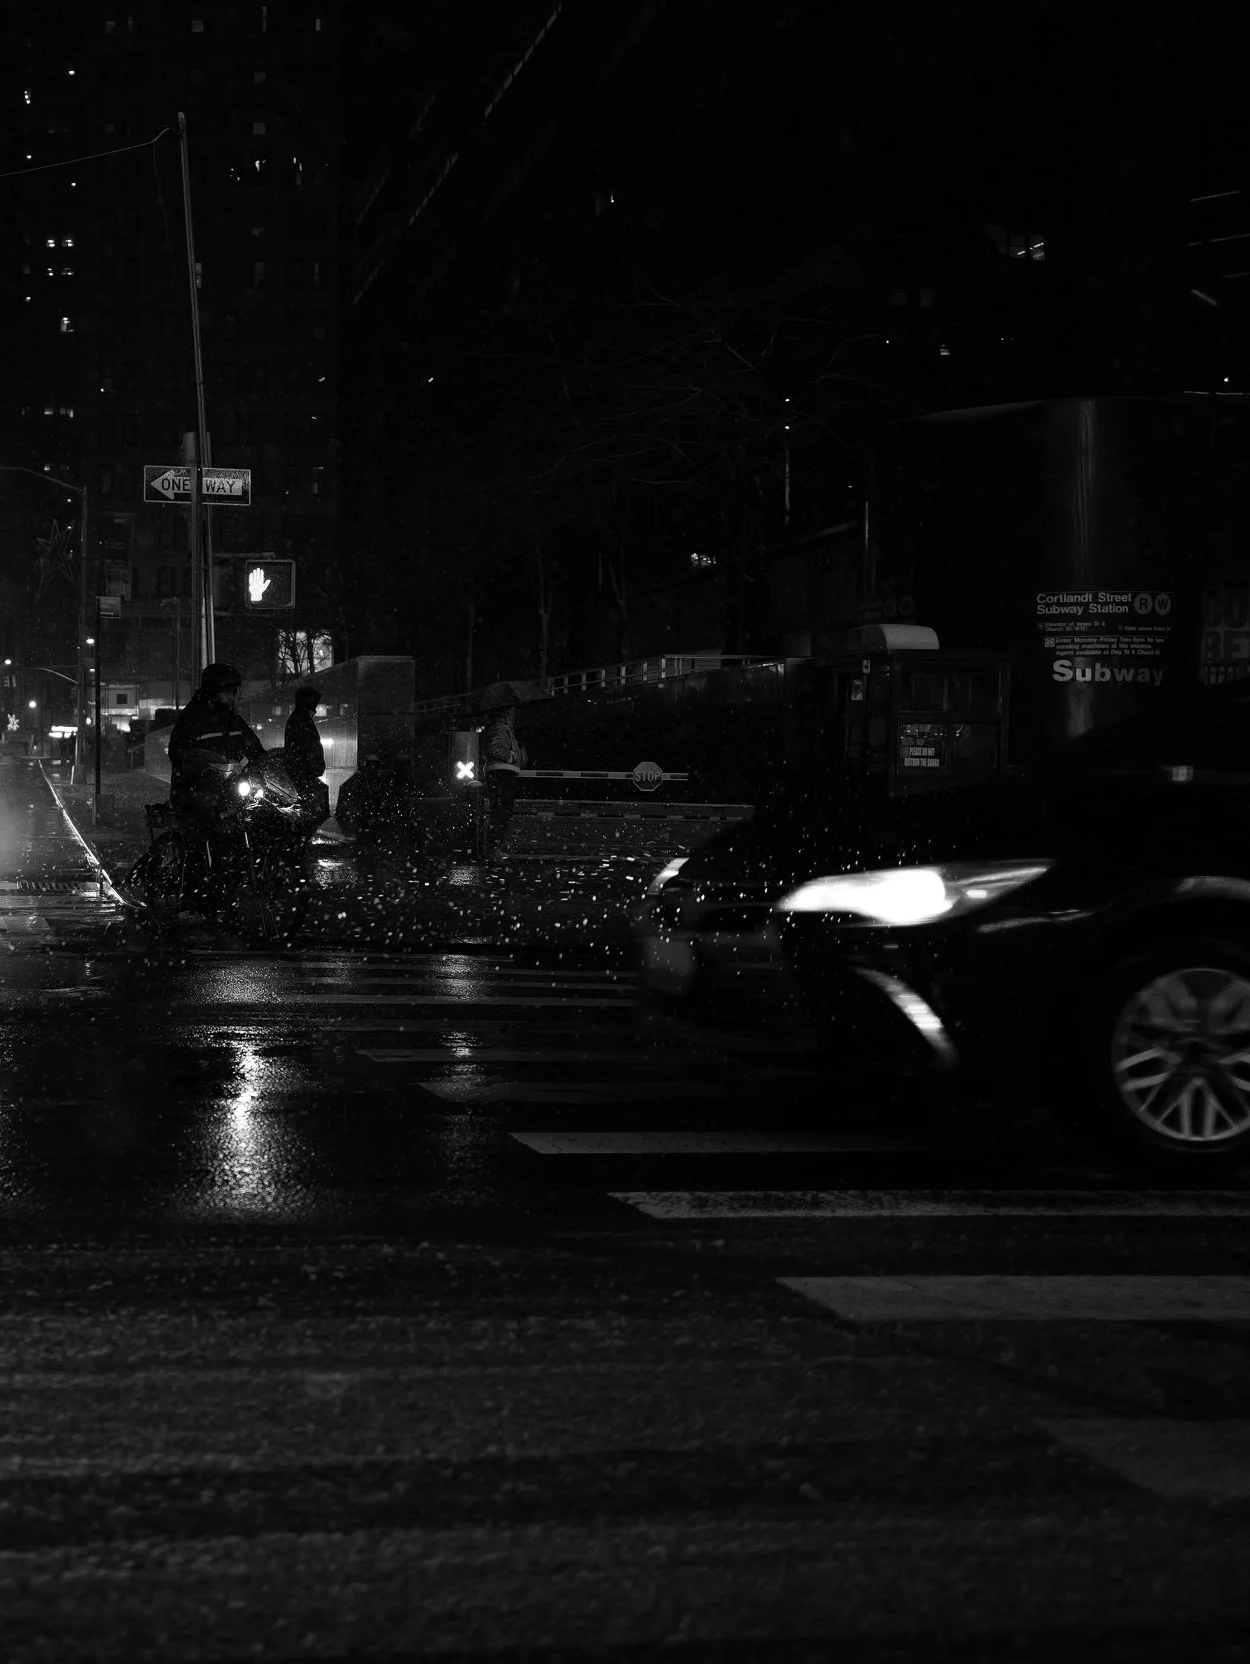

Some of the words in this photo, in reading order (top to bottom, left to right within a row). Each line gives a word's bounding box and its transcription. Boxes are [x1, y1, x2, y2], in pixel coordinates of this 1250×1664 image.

[161, 477, 190, 492] ONE
[205, 479, 236, 494] WAY
[1036, 593, 1093, 604] Cortlandt
[1097, 592, 1132, 603] Street
[1036, 604, 1084, 616] Subway
[1088, 603, 1129, 614] Station
[1052, 659, 1164, 687] Subway
[634, 770, 661, 782] STOP
